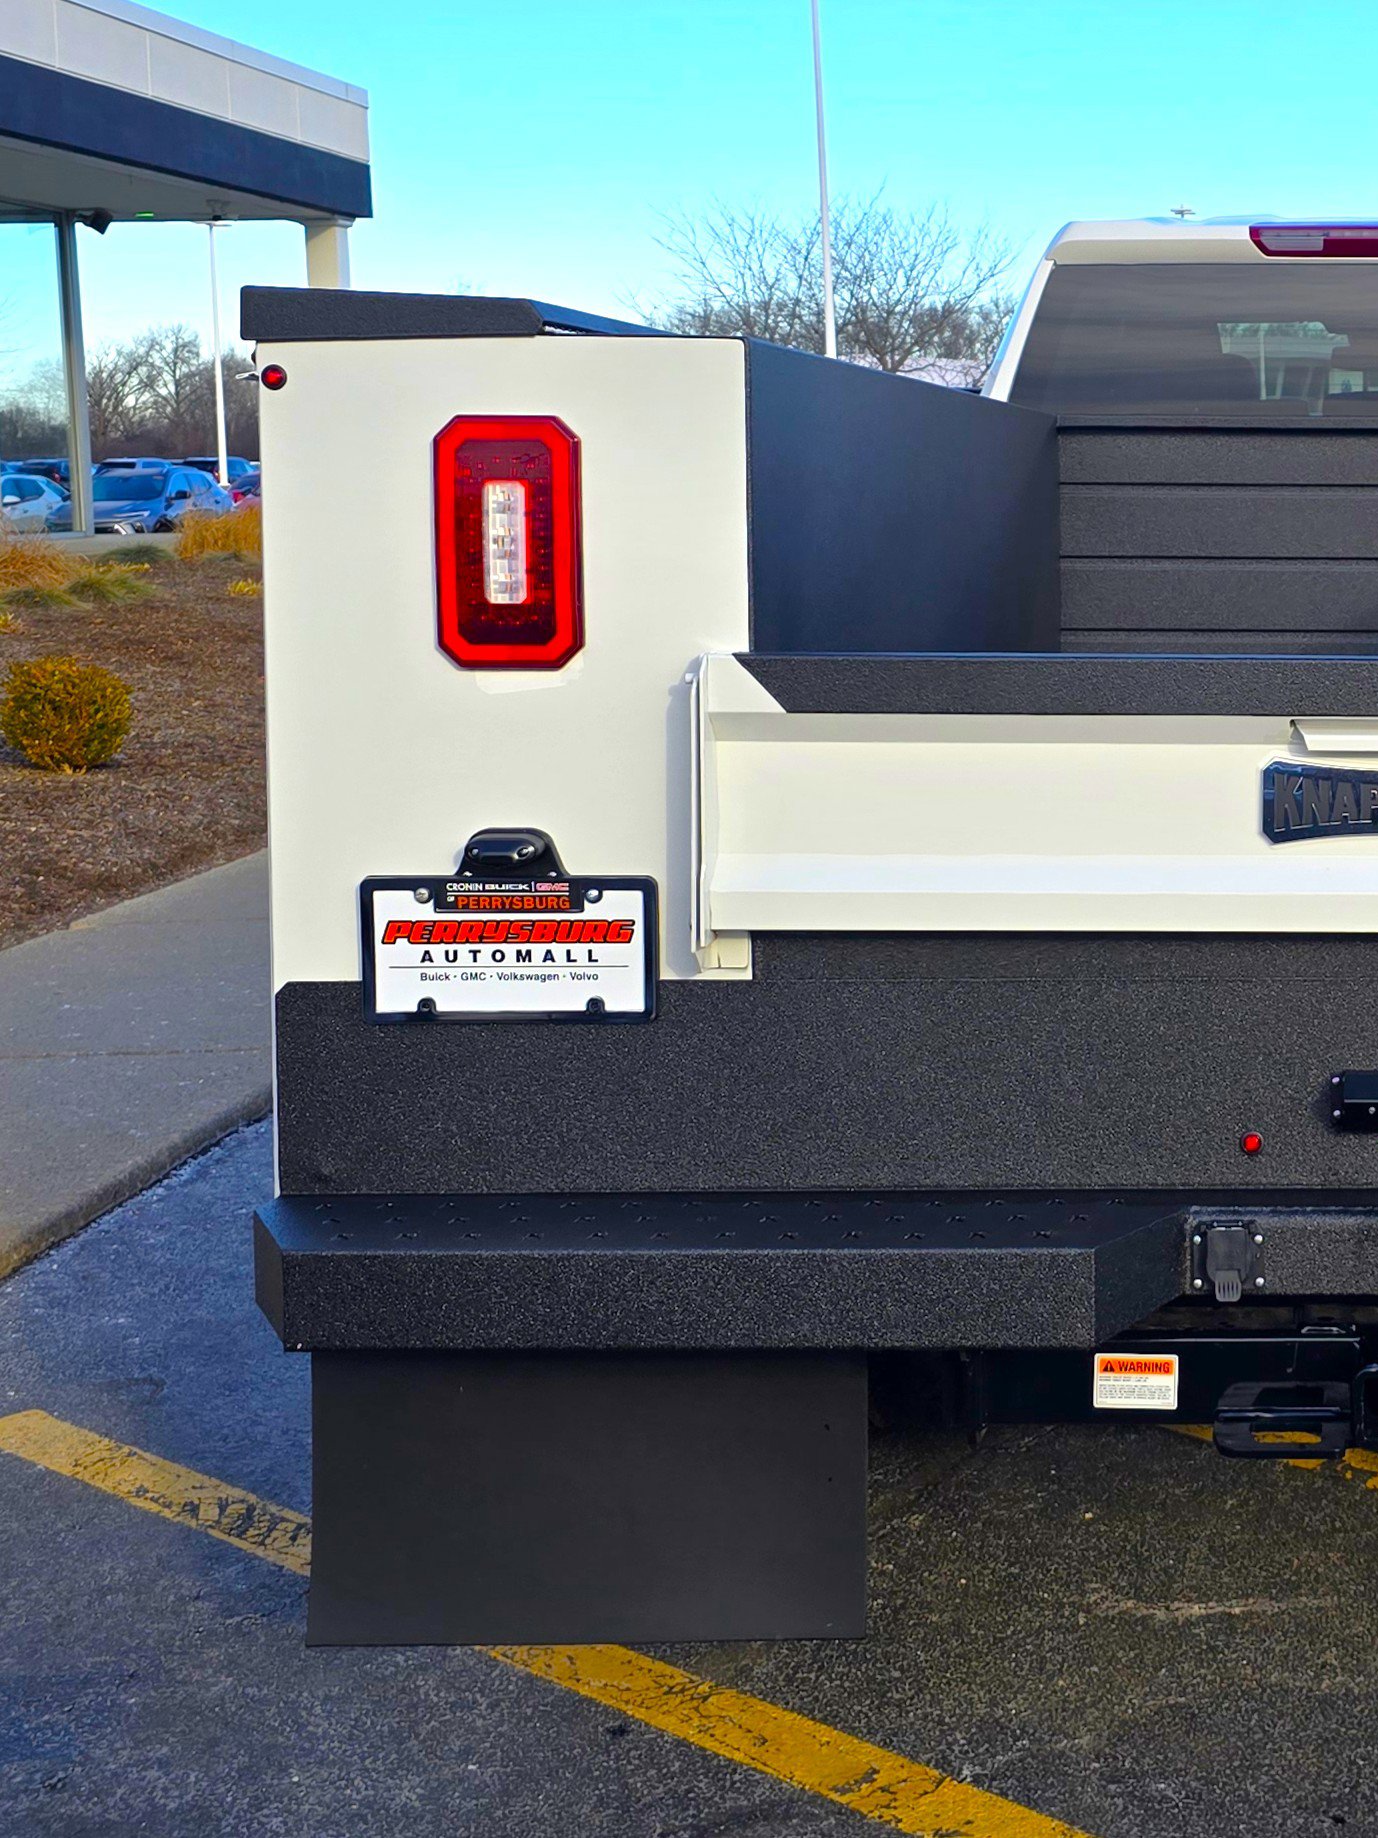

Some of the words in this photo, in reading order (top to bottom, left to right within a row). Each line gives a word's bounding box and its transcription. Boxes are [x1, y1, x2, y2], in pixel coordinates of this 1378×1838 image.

[446, 883, 483, 891] CRONIN
[484, 883, 530, 891] BUICK
[536, 882, 570, 891] GMC
[456, 896, 570, 909] PERRYSBURG
[381, 920, 636, 944] PERRYSBURG
[420, 949, 599, 963] AUTOMALL
[420, 972, 451, 982] Buick
[460, 972, 487, 981] GMC
[496, 971, 560, 983] Volkswagen
[569, 971, 599, 981] Volvo
[1117, 1361, 1170, 1373] WARNING
